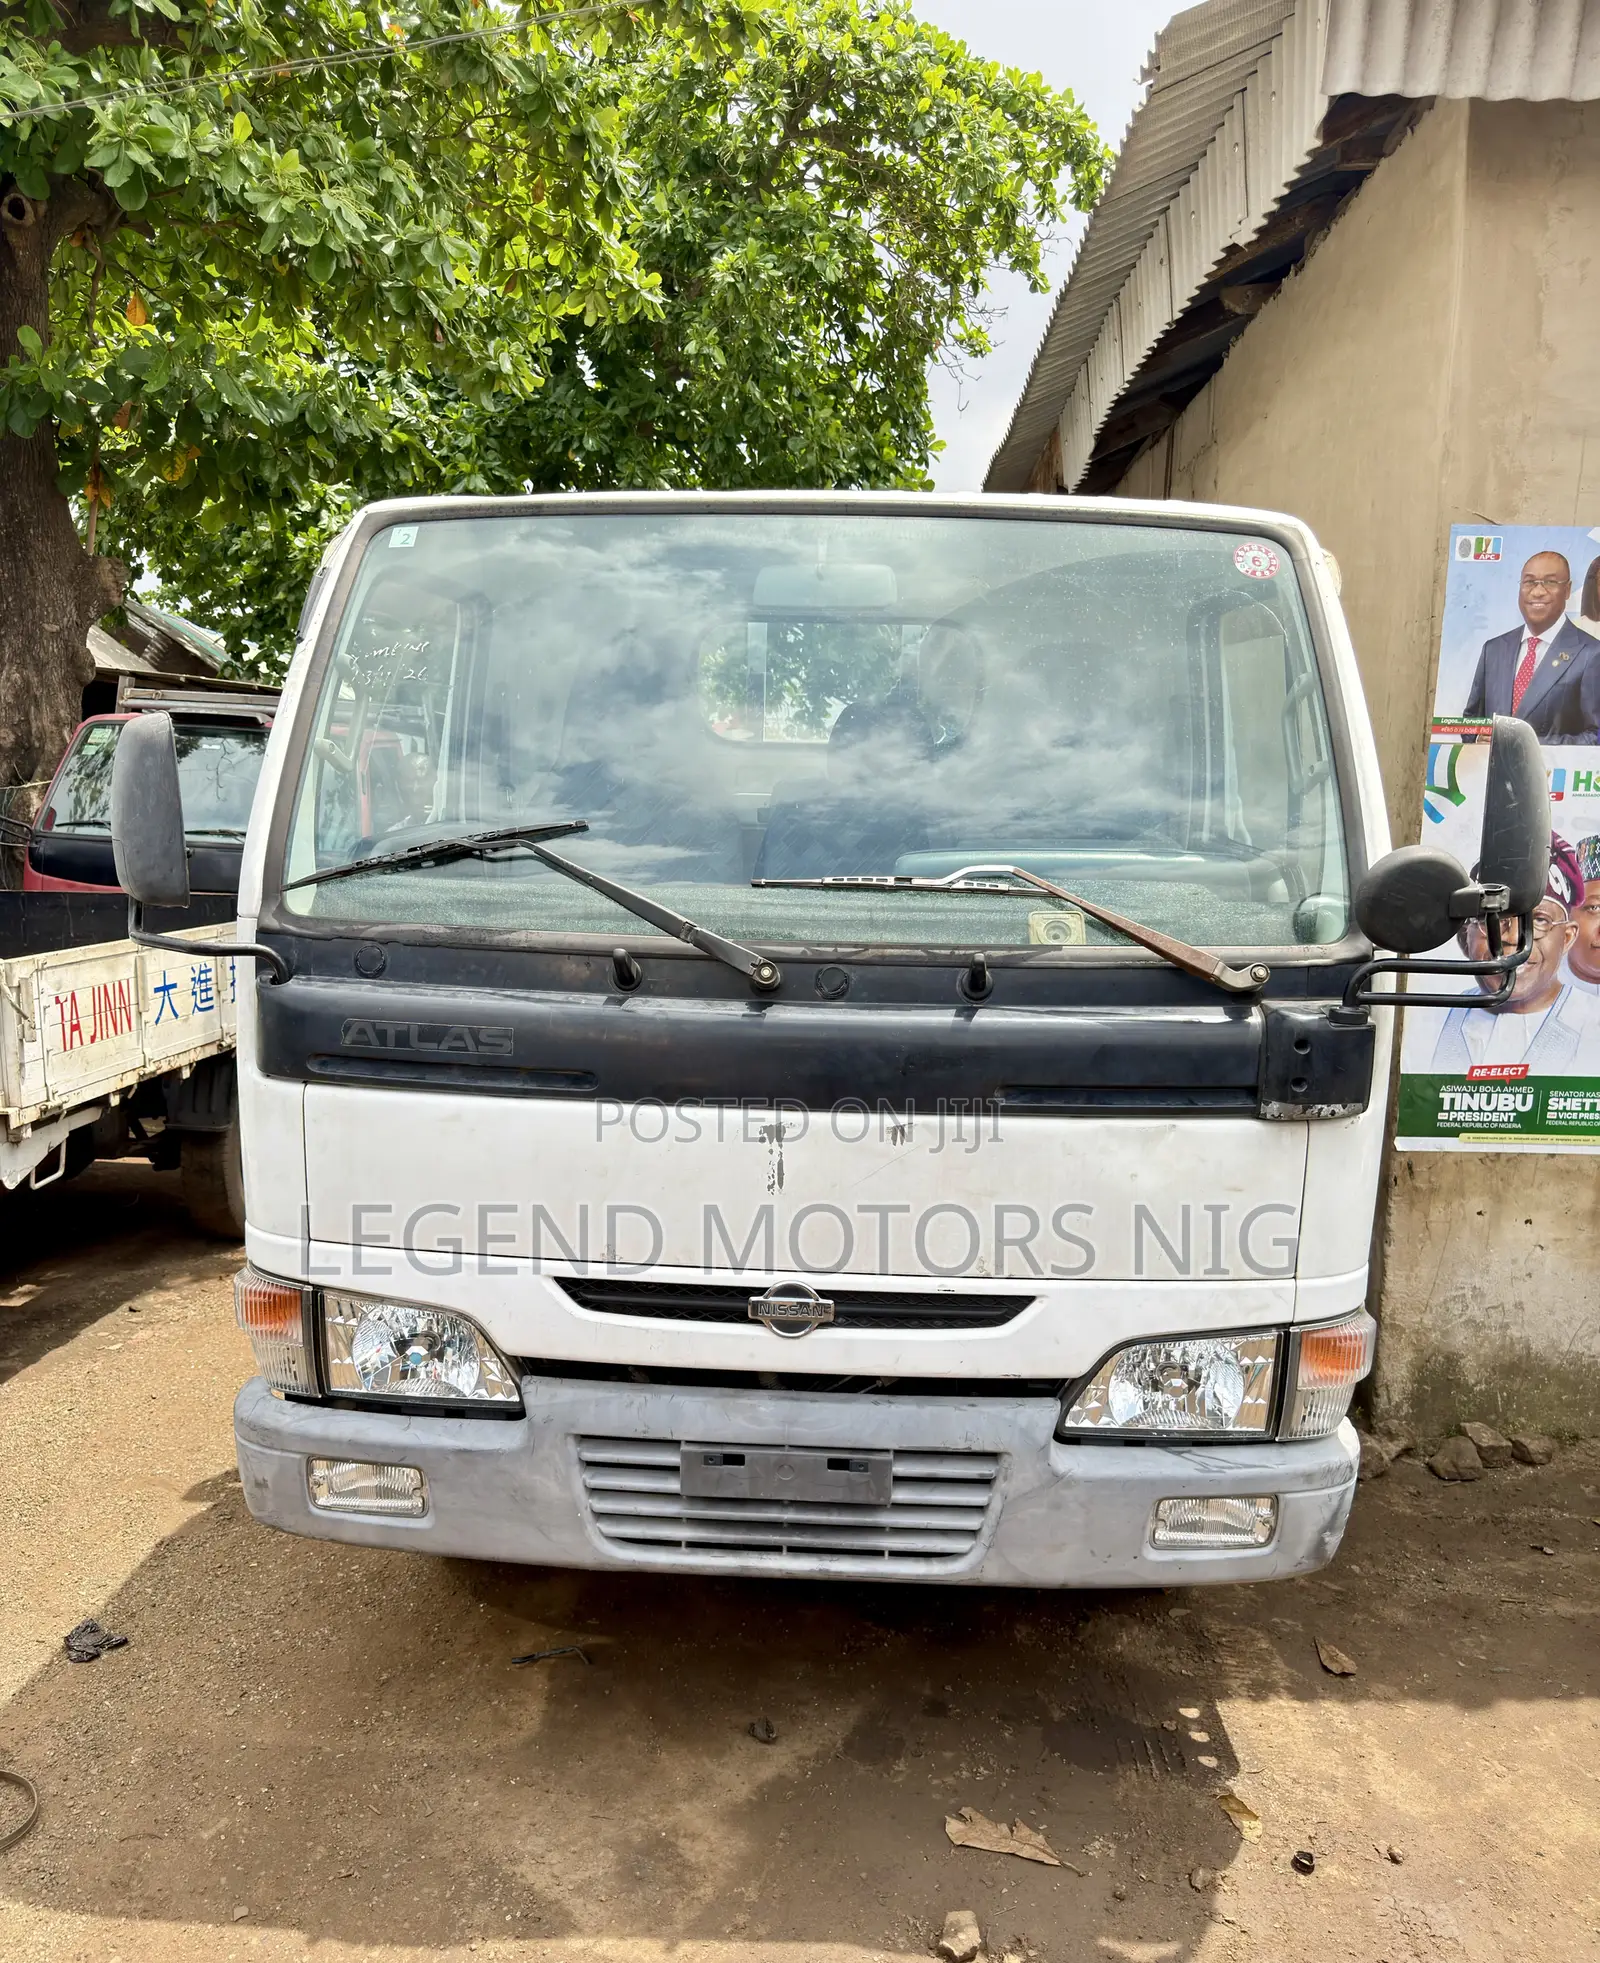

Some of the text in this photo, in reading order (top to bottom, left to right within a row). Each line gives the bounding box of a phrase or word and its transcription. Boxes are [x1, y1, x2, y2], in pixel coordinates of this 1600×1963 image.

[400, 533, 411, 545] 2
[342, 1021, 511, 1053] ATLAS
[1472, 1067, 1525, 1077] RE-ELECT
[1440, 1085, 1478, 1093] ASIWAJU
[1502, 1086, 1534, 1094] AHMED
[1439, 1093, 1534, 1112] TINUBU
[1449, 1112, 1516, 1122] PRESIDENT
[758, 1303, 824, 1318] NISSAN
